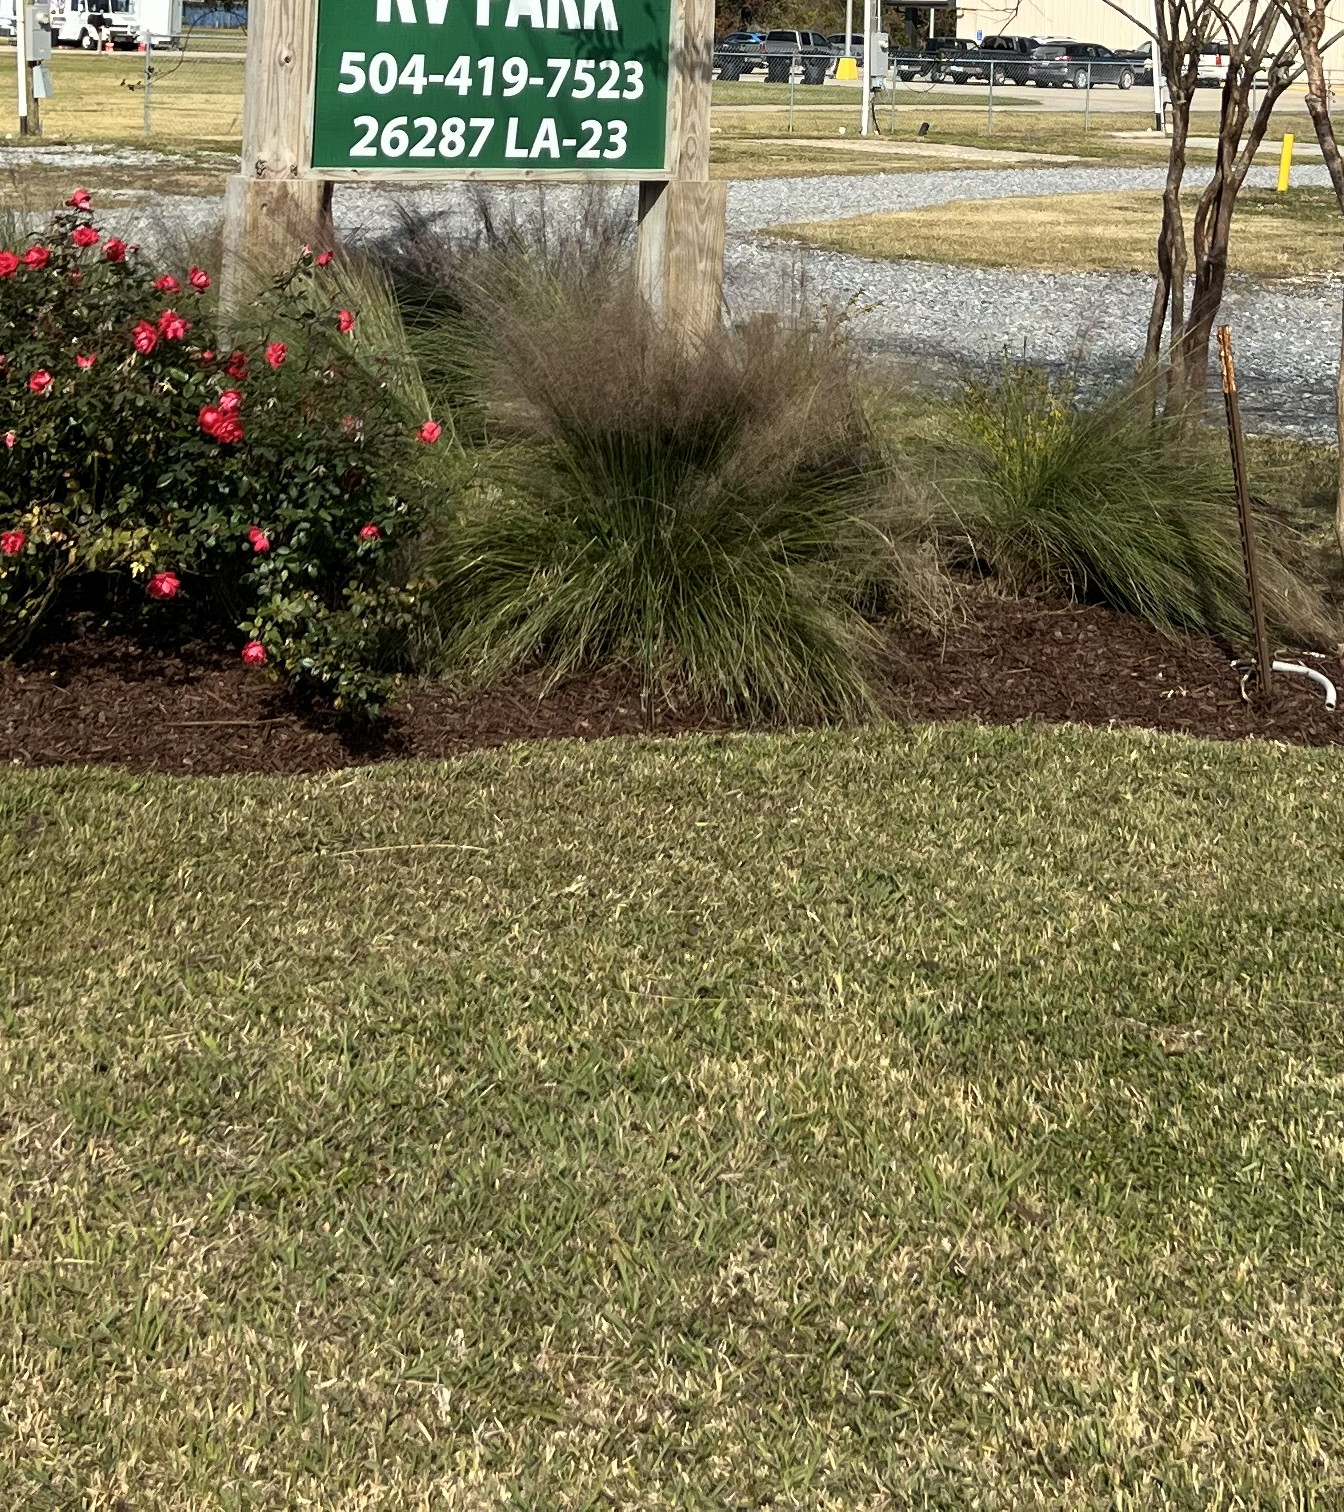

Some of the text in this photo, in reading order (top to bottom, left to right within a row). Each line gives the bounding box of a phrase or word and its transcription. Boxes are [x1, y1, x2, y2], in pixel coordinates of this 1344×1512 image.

[337, 51, 645, 100] 504-419-7523
[349, 115, 629, 159] 26287 LA-23
